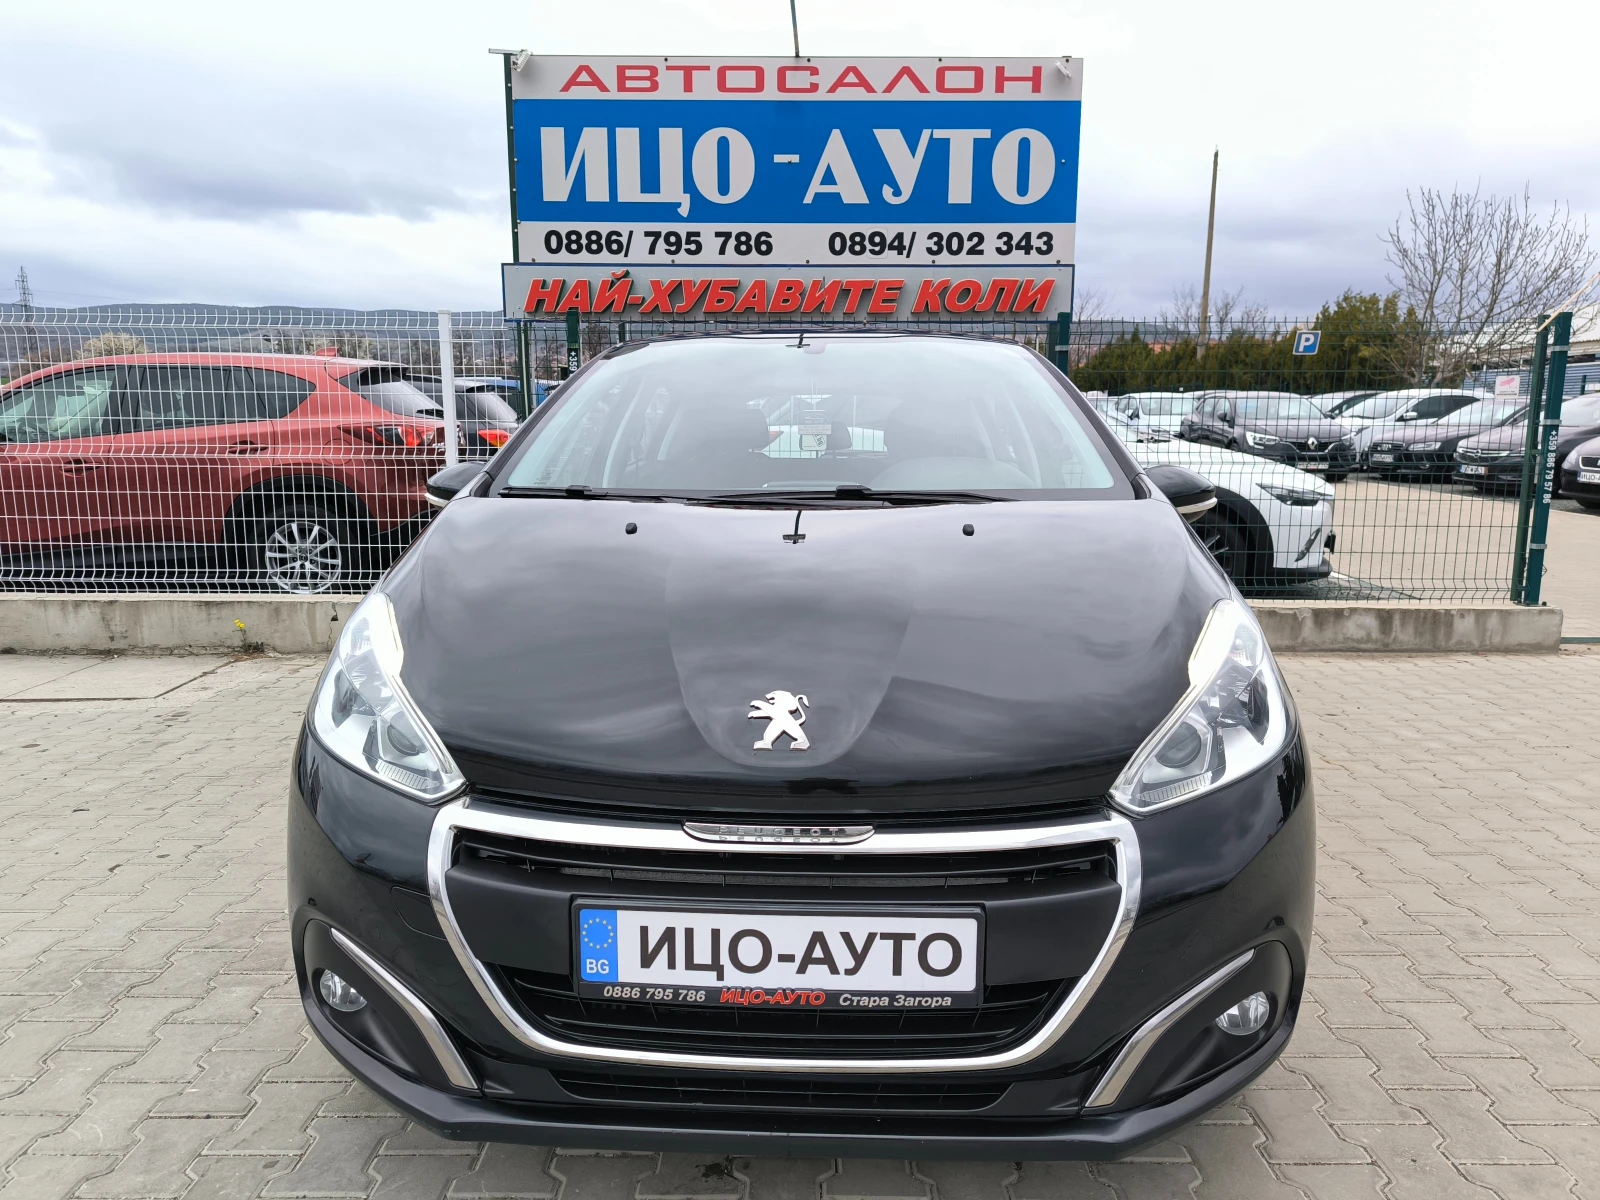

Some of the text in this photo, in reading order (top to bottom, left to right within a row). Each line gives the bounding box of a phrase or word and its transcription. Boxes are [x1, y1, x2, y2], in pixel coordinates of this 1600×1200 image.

[559, 64, 1042, 94] АВТОСАЛОН
[544, 229, 1054, 258] 0886/ 795 786 0894/ 302 343
[524, 270, 1057, 314] НАЙ-ХУБАВИТЕ КОЛИ
[1298, 333, 1315, 352] P
[569, 351, 578, 371] +359
[1549, 430, 1558, 451] +359
[1545, 470, 1554, 480] 79
[1544, 482, 1553, 492] 57
[718, 826, 842, 836] PEUGEOT
[639, 925, 963, 981] ИЦО-АУТО
[586, 958, 610, 974] BG
[603, 985, 952, 1008] 0886 795 786 ИЦО-АУТО Стара Загора
